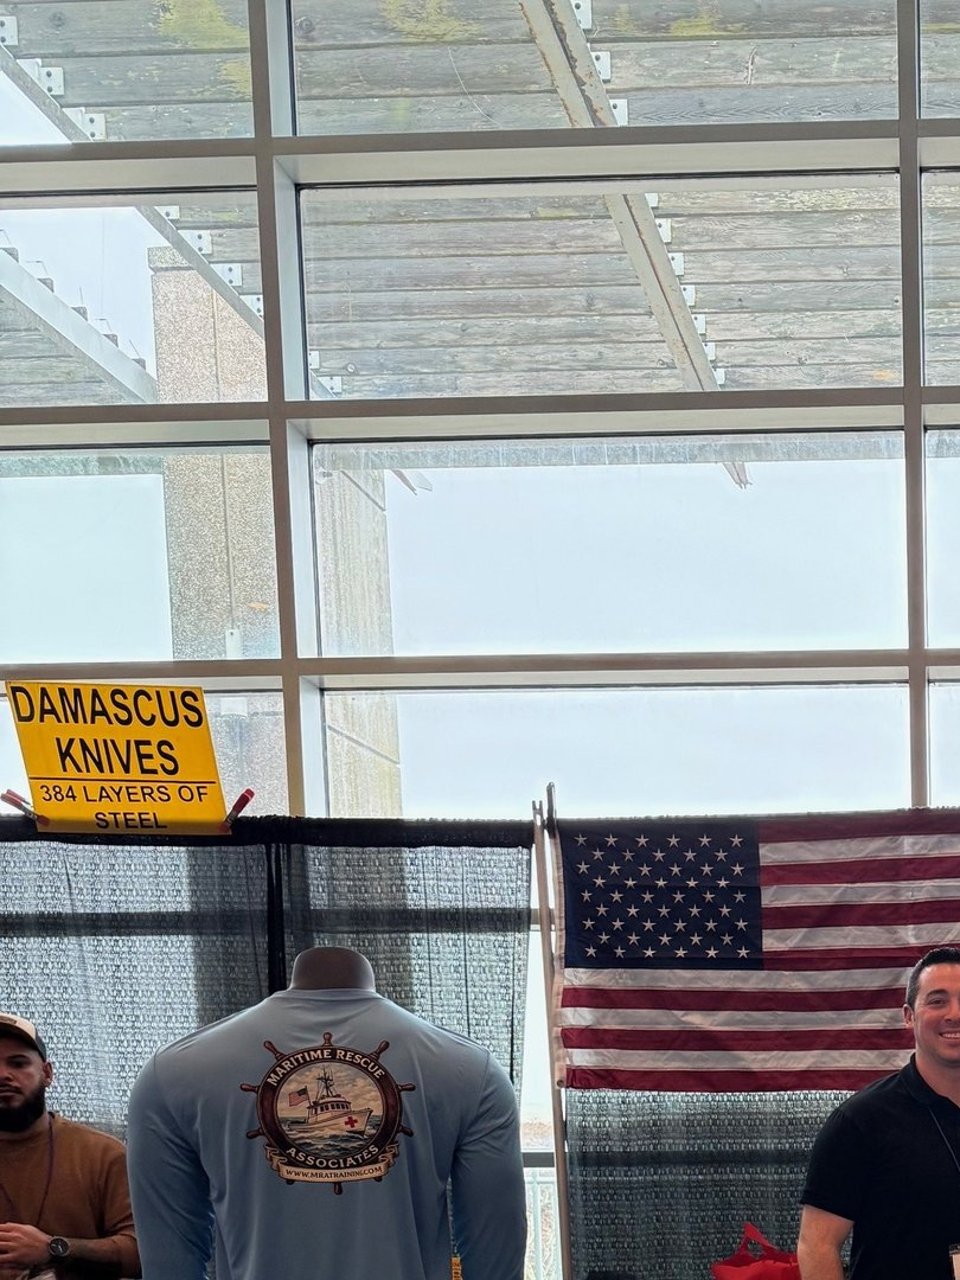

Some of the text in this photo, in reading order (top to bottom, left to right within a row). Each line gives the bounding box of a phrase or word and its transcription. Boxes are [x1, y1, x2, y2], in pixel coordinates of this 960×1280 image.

[10, 686, 204, 727] DAMASCUS
[56, 737, 180, 776] KNIVES
[40, 785, 209, 802] 384 LAYERS OF
[95, 812, 167, 829] STEEL
[267, 1049, 385, 1086] MARITIME RESCUE
[286, 1144, 379, 1169] ASSOCIATES
